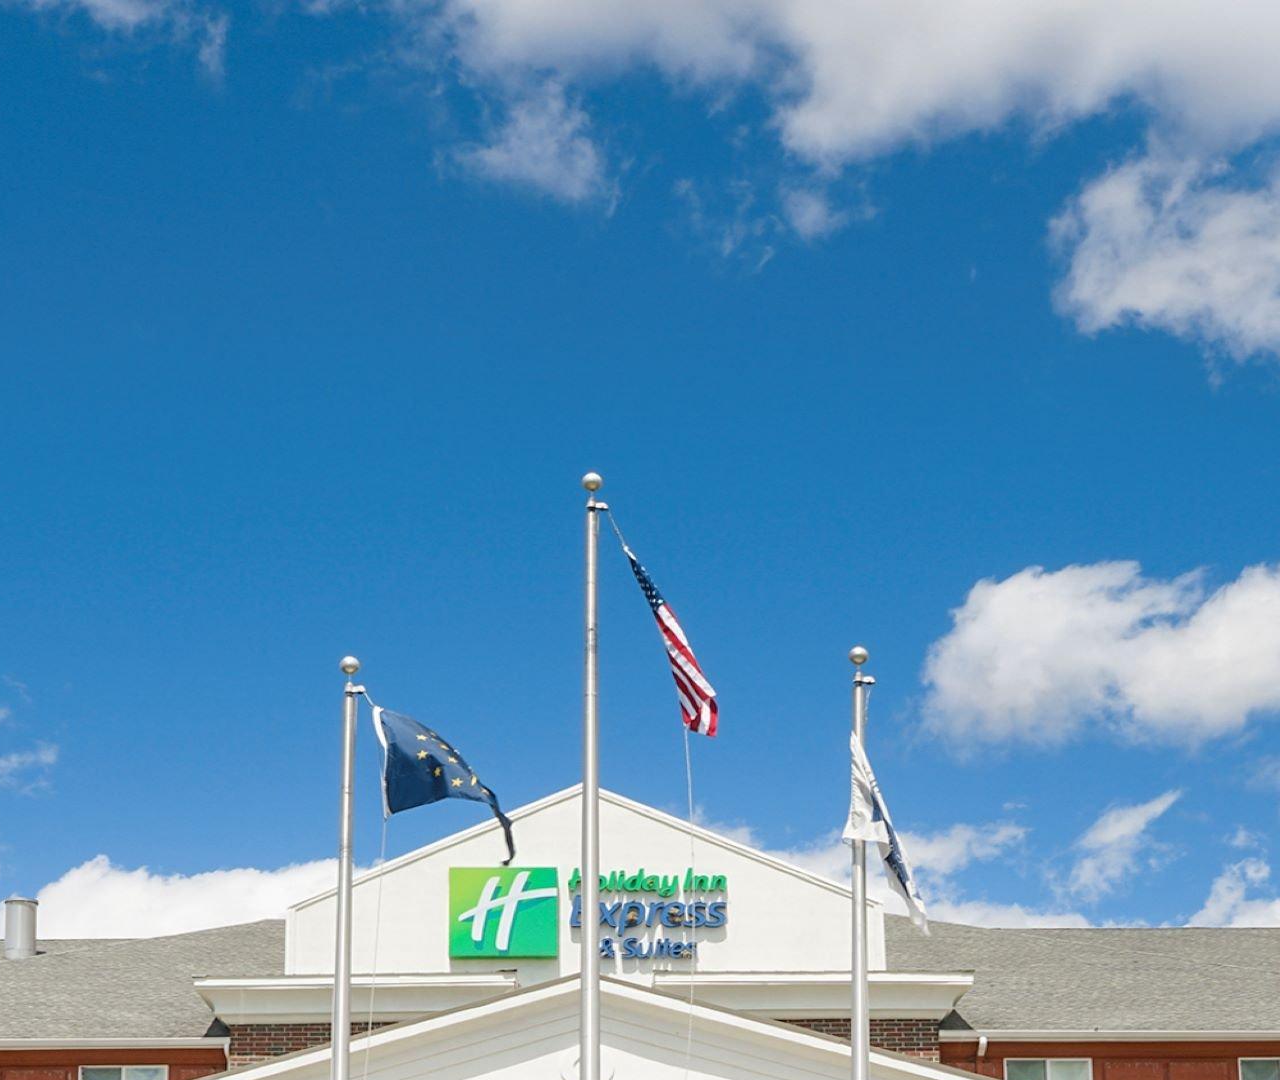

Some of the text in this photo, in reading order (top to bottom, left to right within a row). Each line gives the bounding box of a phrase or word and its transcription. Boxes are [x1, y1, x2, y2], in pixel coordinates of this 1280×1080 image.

[683, 867, 727, 892] Inn
[600, 937, 697, 959] & Suites
